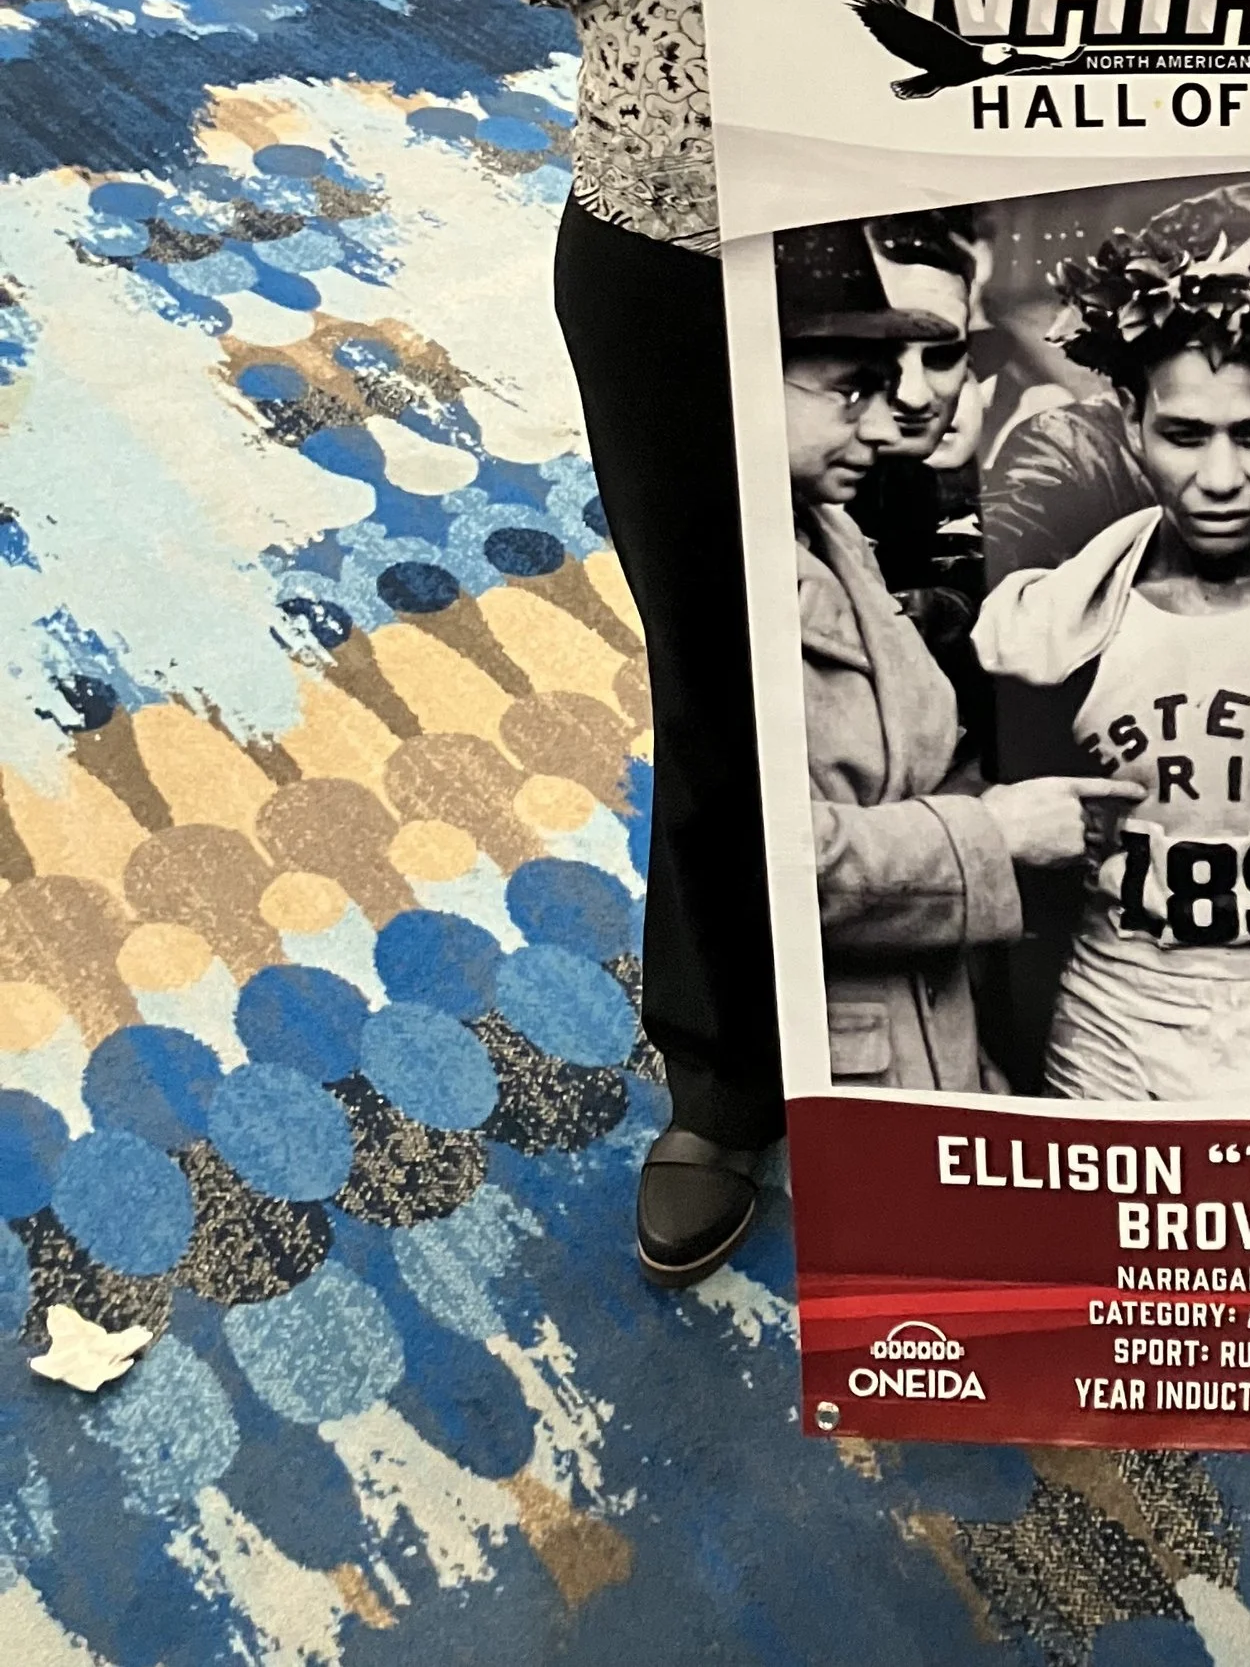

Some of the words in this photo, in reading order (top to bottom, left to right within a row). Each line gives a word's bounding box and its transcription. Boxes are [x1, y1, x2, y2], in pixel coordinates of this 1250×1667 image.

[1086, 55, 1149, 69] NORTH
[972, 84, 1147, 129] HALL
[1171, 82, 1248, 127] OF
[937, 1136, 1182, 1194] ELLISON
[1088, 1300, 1236, 1328] CATEGORY:
[1114, 1338, 1209, 1366] SPORT:
[848, 1368, 986, 1400] ONEIDA
[1074, 1377, 1146, 1410] YEAR
